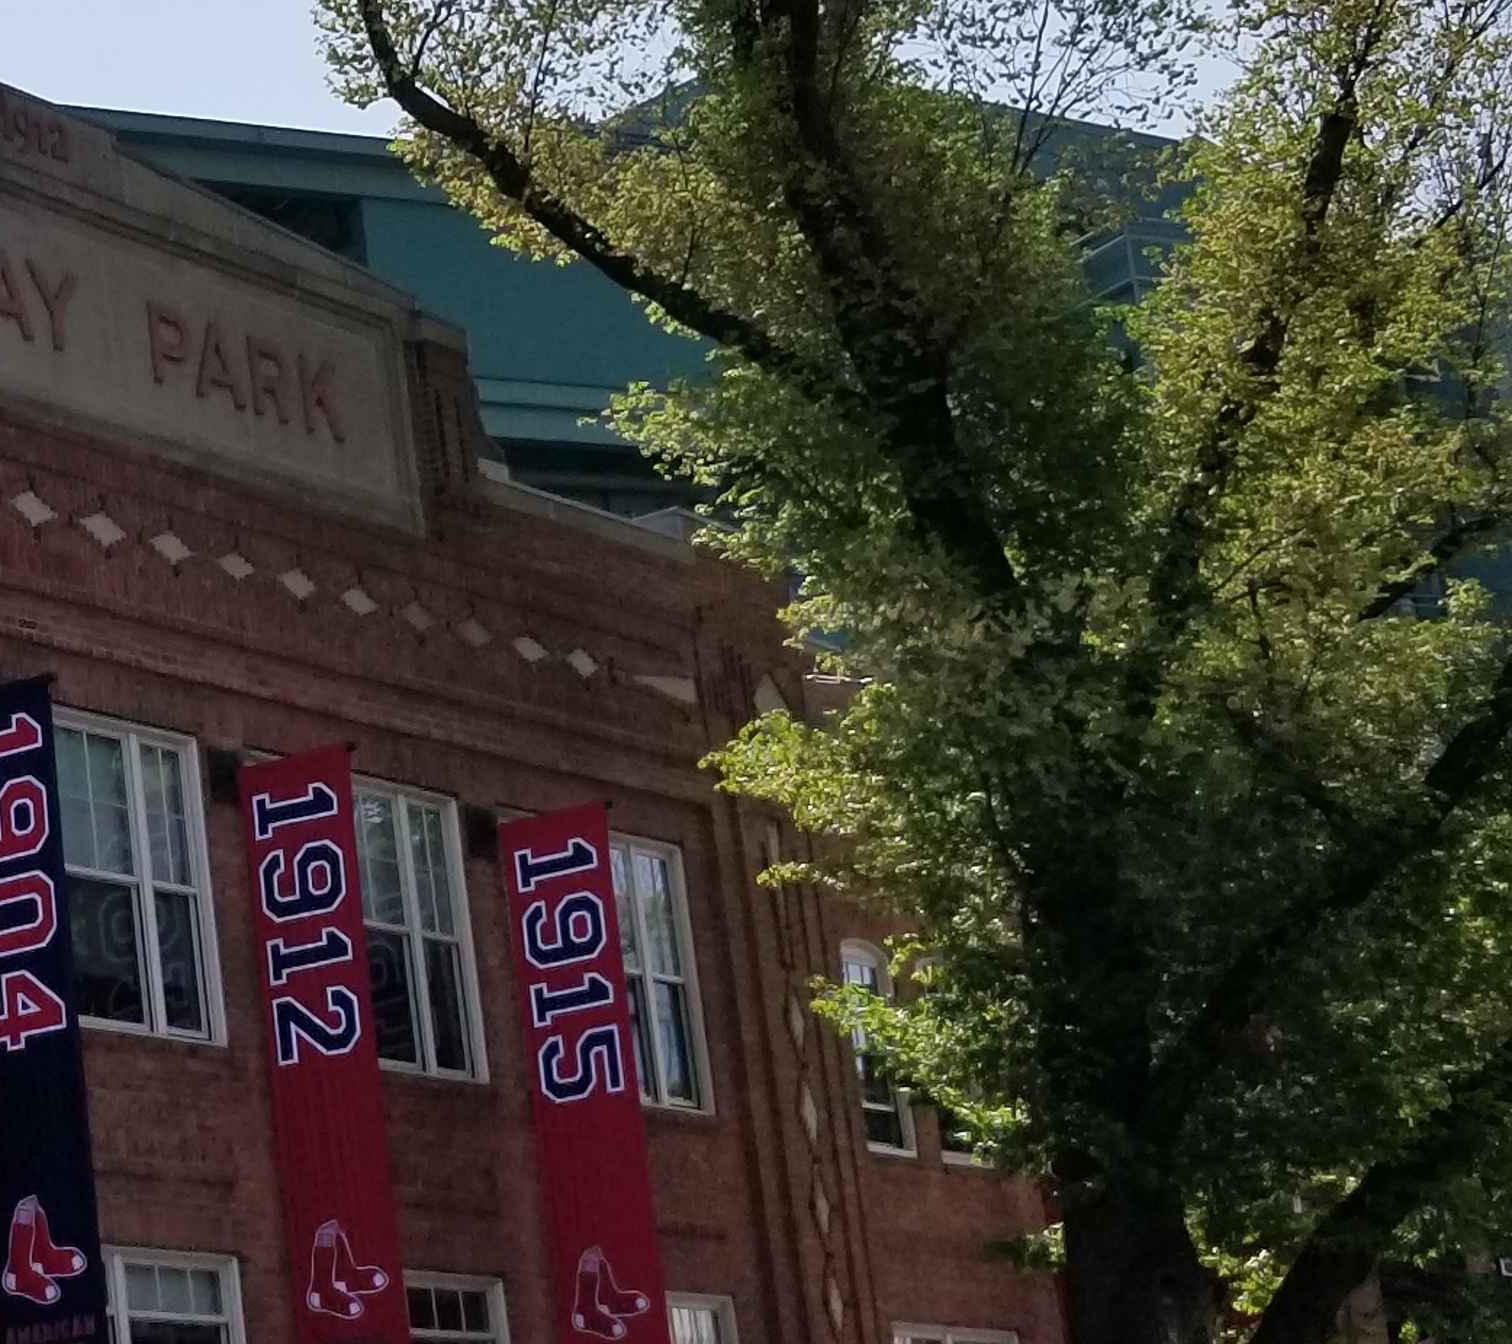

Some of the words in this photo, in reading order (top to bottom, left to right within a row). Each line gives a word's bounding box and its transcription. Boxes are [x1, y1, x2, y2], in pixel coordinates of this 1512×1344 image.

[146, 300, 347, 445] PARK
[251, 781, 362, 1067] 1912
[513, 836, 625, 1104] 1915
